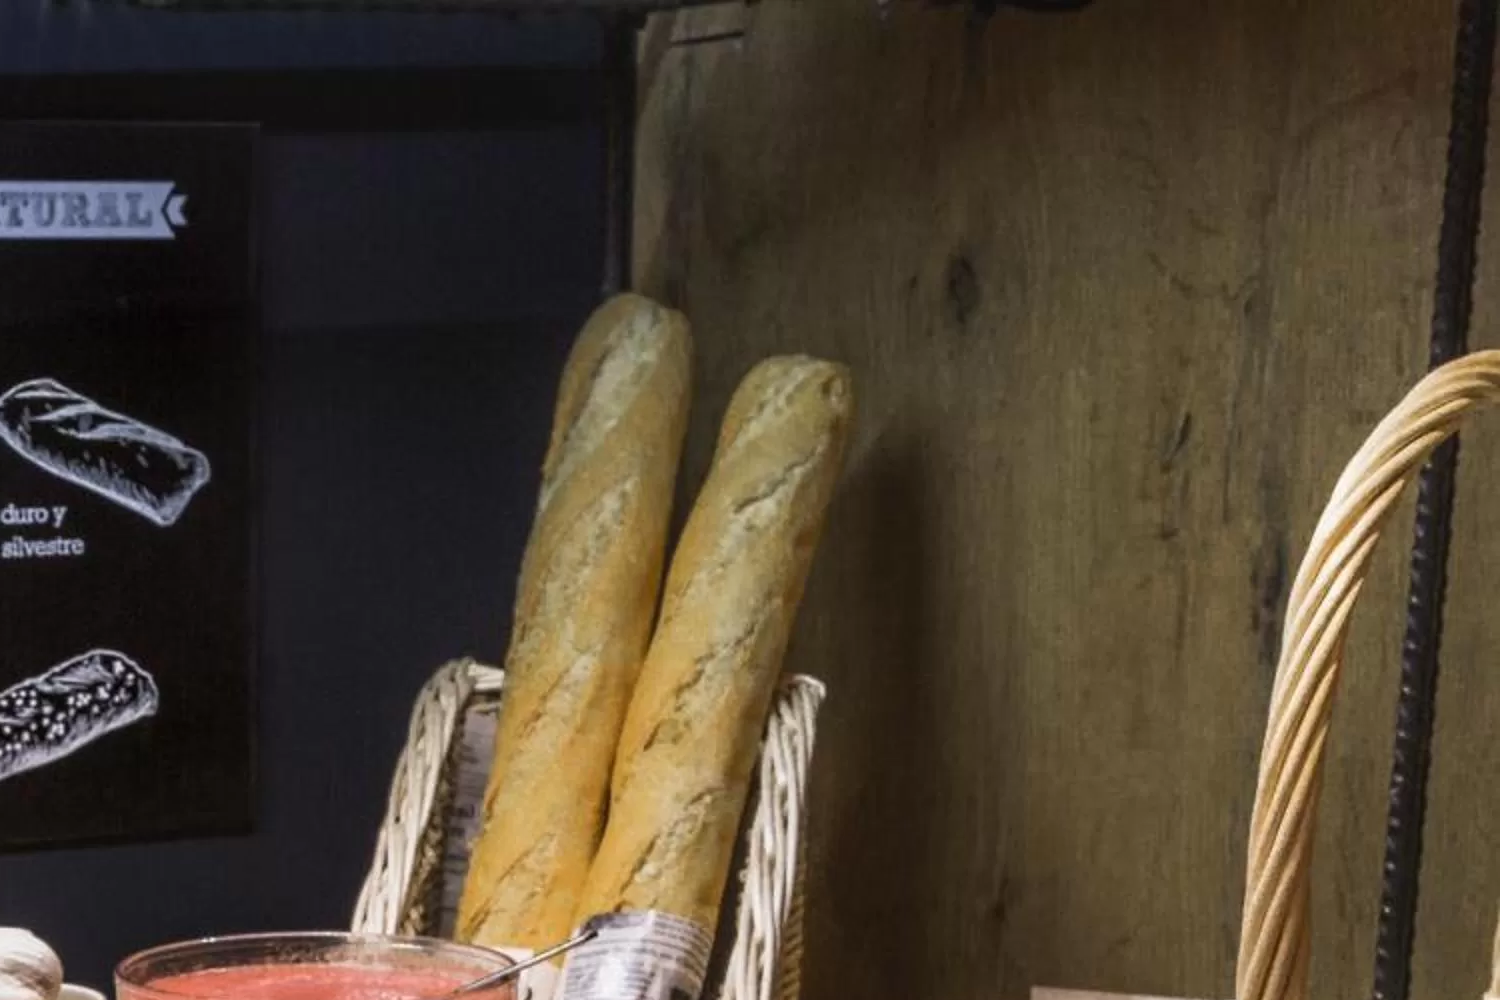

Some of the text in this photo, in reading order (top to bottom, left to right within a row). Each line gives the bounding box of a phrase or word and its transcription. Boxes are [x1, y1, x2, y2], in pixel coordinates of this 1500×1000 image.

[1, 503, 49, 525] duro
[52, 506, 68, 528] y
[2, 535, 85, 558] silvestre
